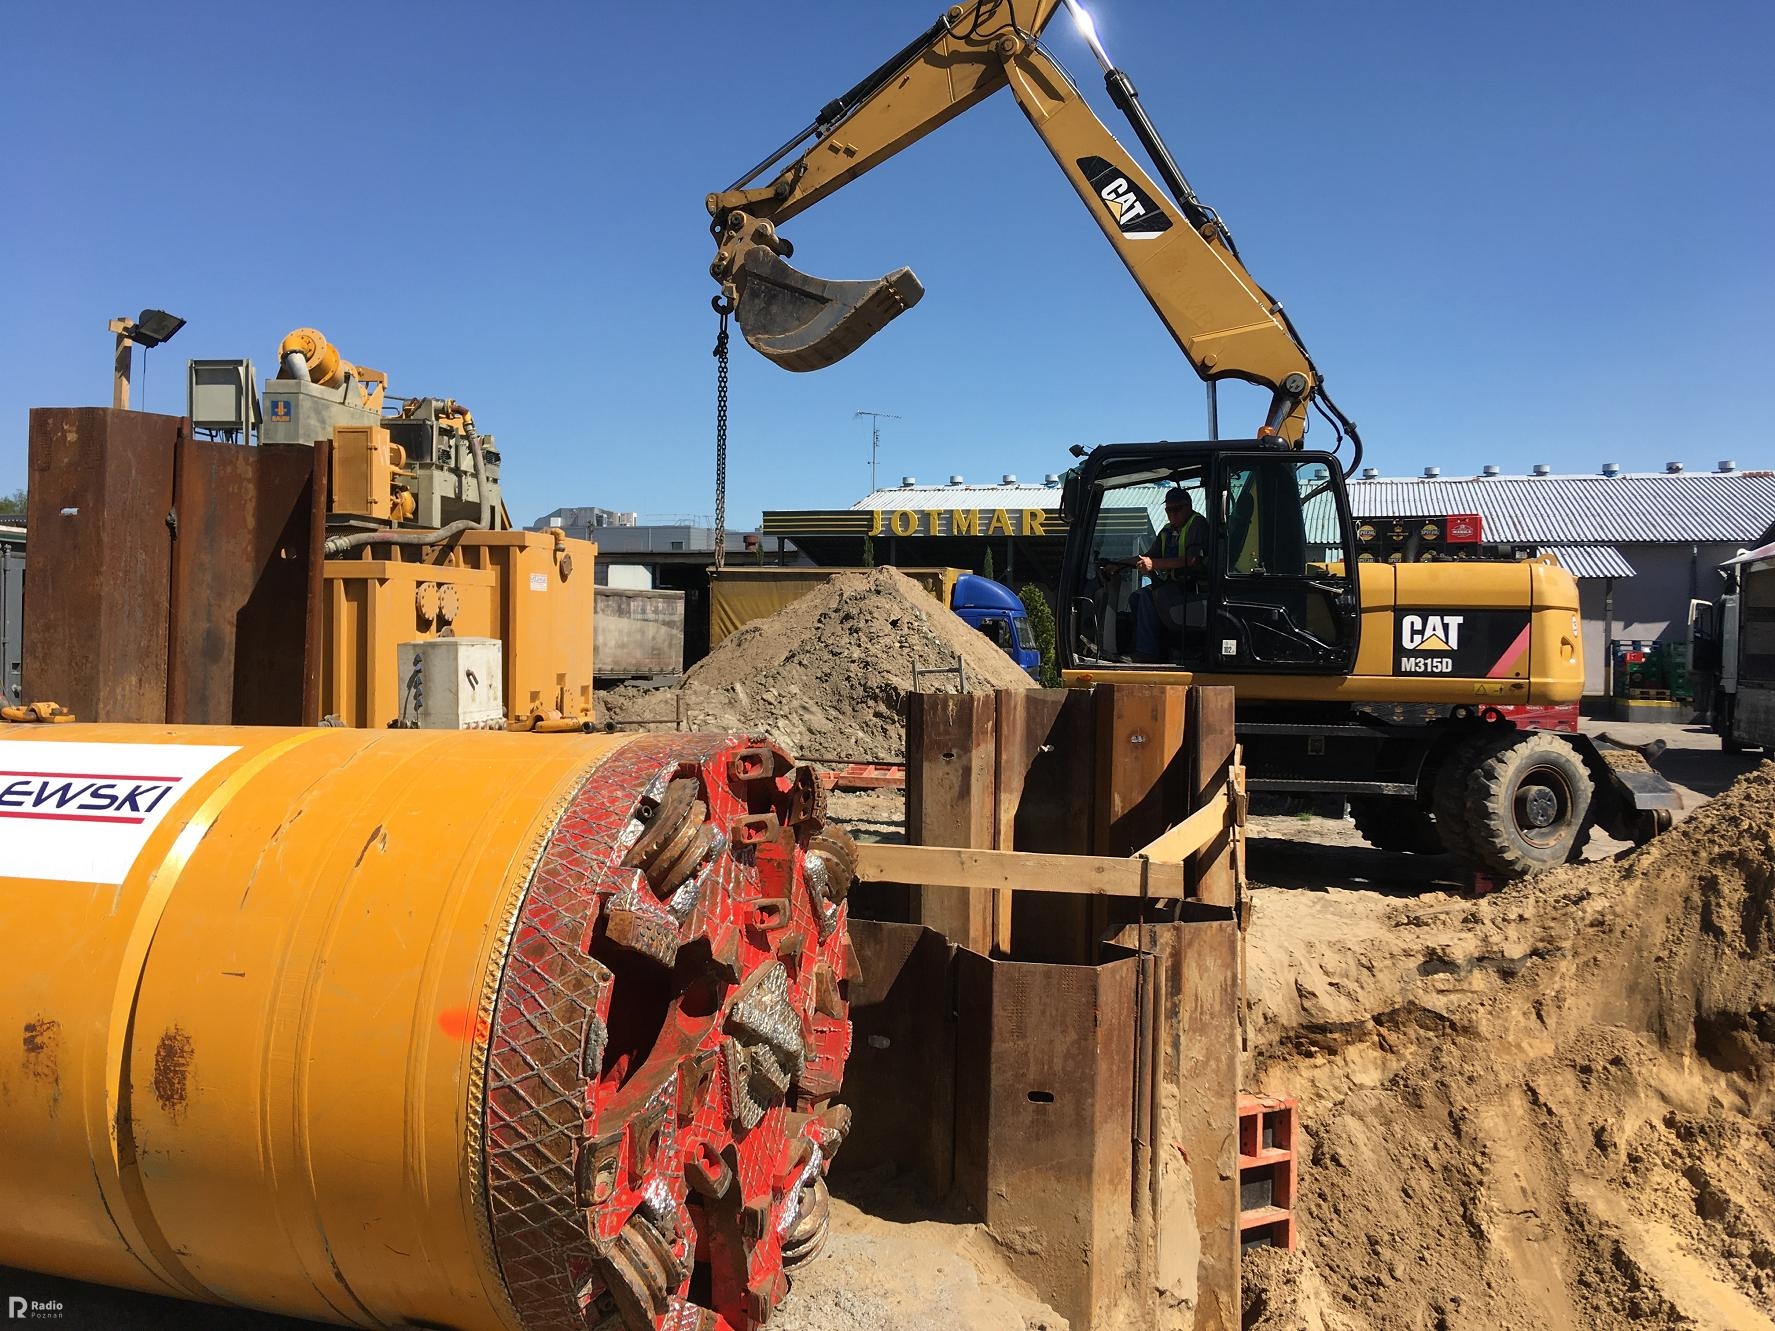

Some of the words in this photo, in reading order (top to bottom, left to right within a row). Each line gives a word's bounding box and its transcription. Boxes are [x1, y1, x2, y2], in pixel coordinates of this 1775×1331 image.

[1101, 177, 1146, 225] CAT
[868, 509, 1046, 536] JOTMAR
[1402, 615, 1464, 650] CAT
[1401, 657, 1453, 673] M315D
[0, 780, 173, 812] EWSKI
